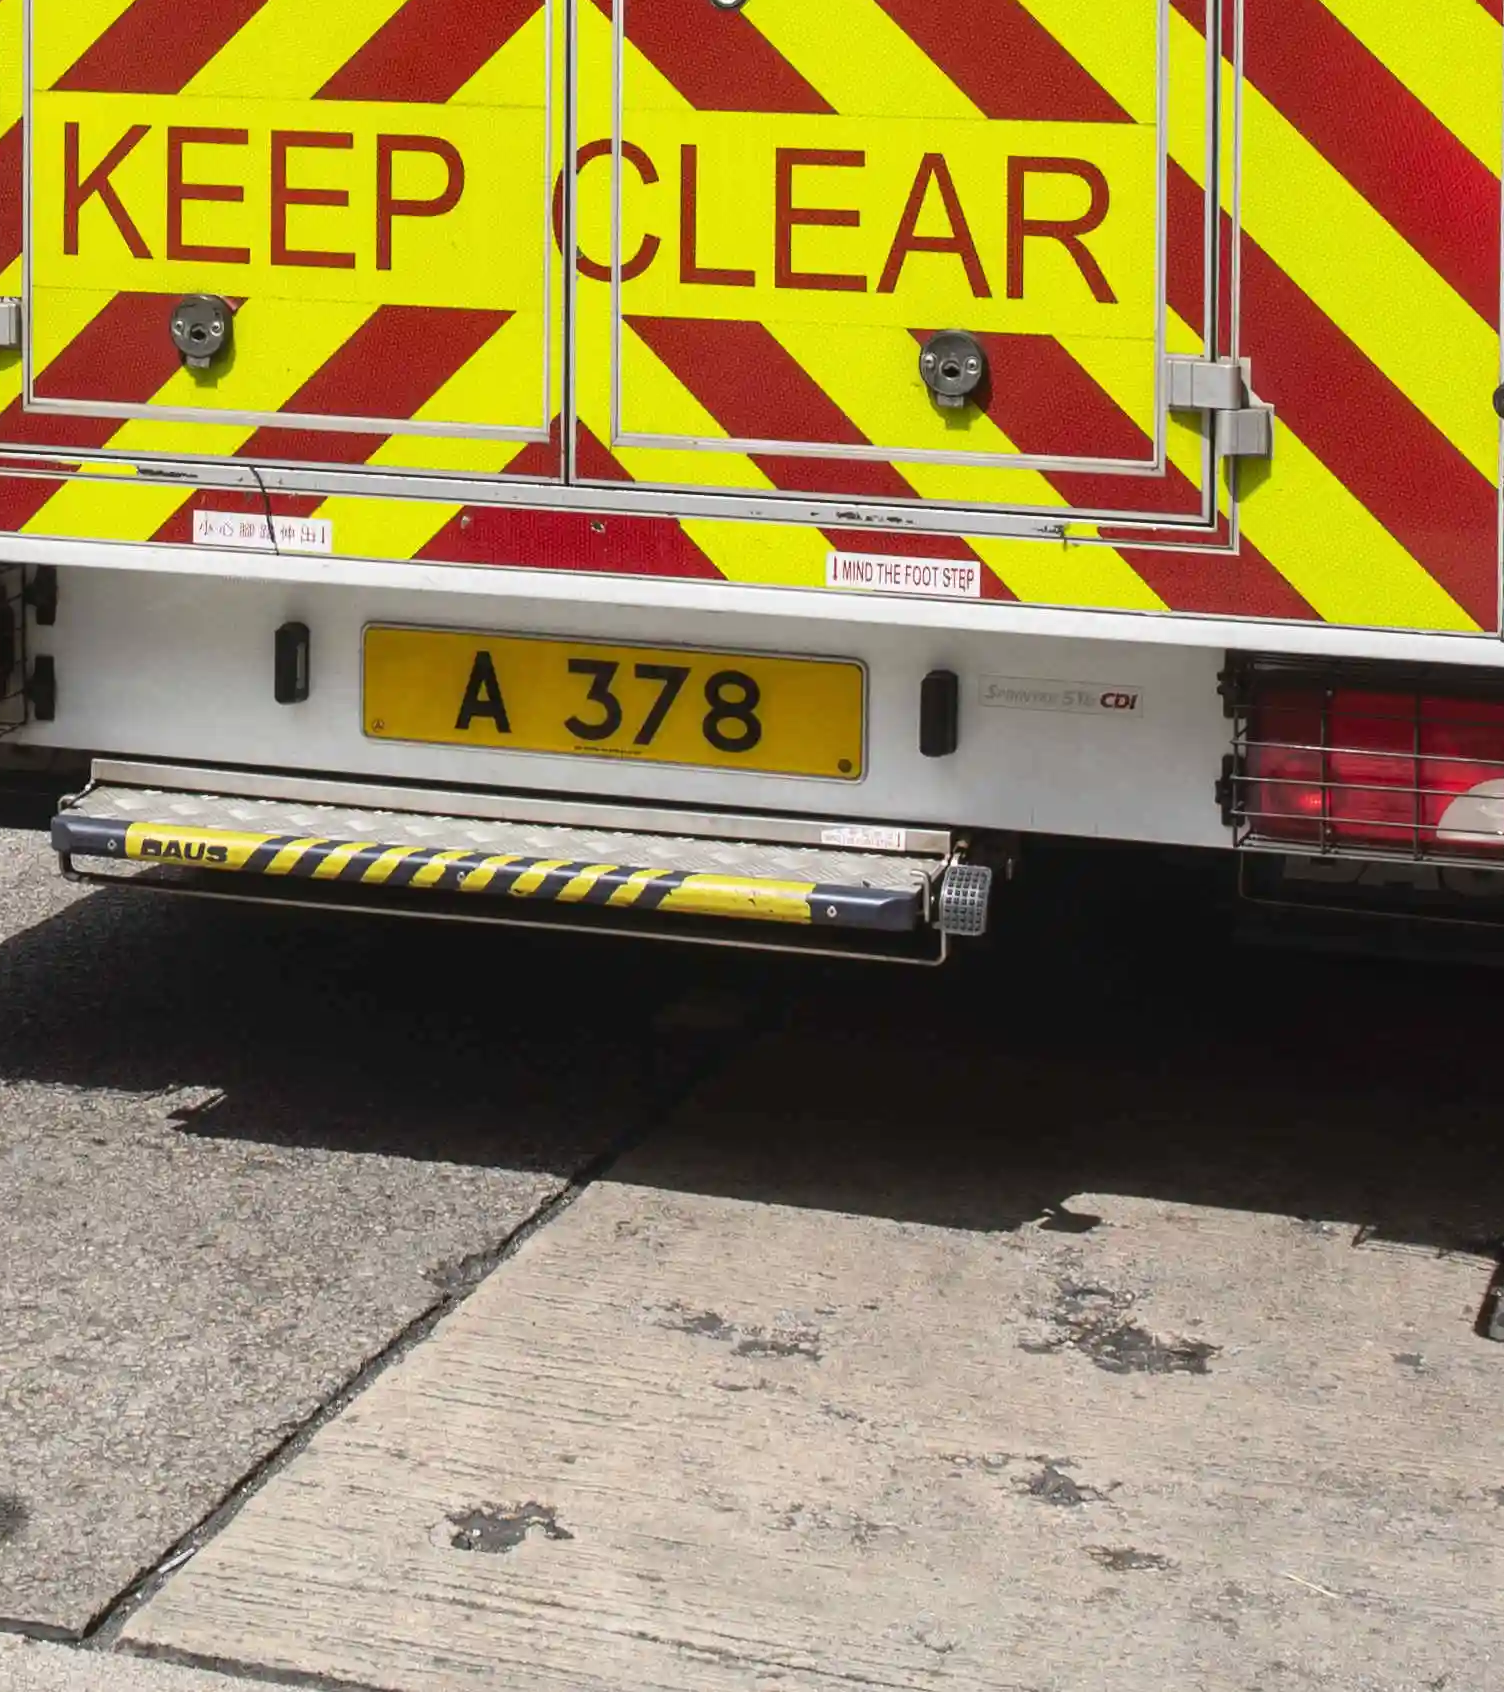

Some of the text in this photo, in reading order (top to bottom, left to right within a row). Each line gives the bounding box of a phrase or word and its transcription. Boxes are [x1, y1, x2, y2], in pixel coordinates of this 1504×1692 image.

[62, 119, 1120, 305] KEEP CLEAR
[842, 559, 975, 592] MIND THE FOOT STEP
[454, 650, 764, 754] A 378
[1099, 692, 1138, 710] CDI
